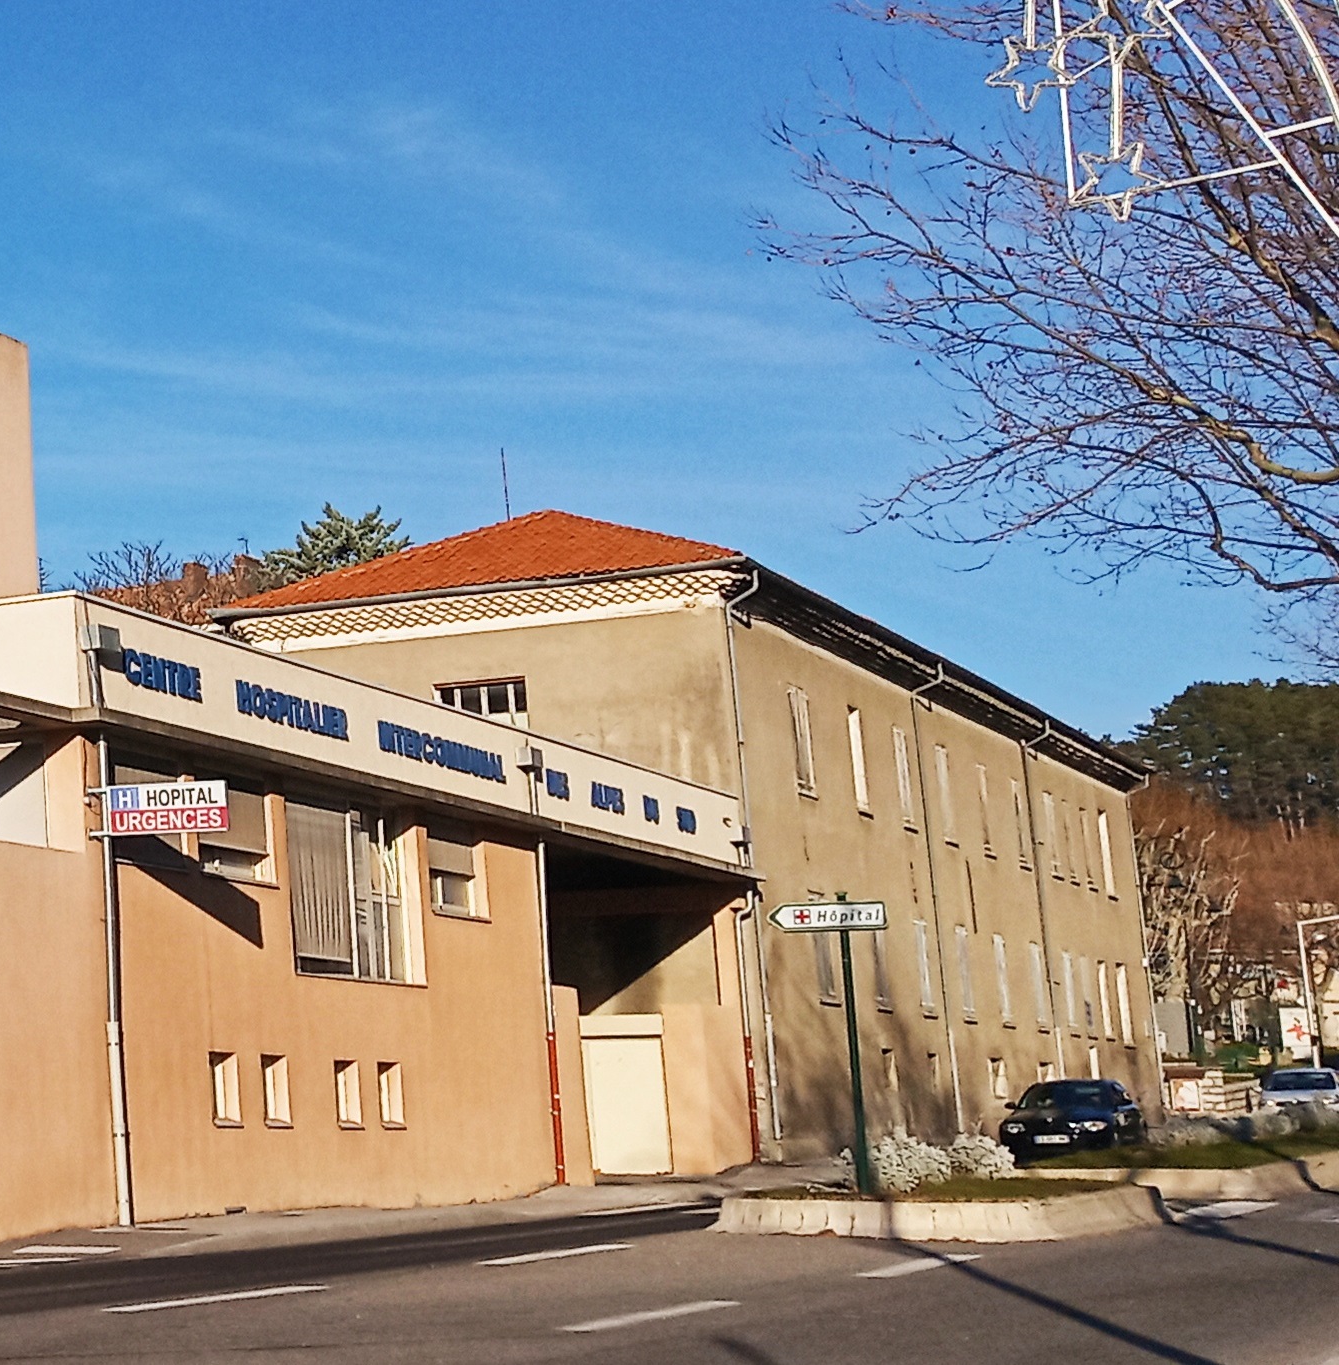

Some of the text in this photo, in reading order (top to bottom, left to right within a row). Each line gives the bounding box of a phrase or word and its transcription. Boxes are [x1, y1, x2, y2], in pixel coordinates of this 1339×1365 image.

[125, 648, 203, 704] CENTRE
[235, 679, 350, 742] HOSPITALIER
[146, 786, 219, 807] HOPITAL
[114, 808, 223, 832] URGENCES
[816, 908, 880, 924] Hôpital
